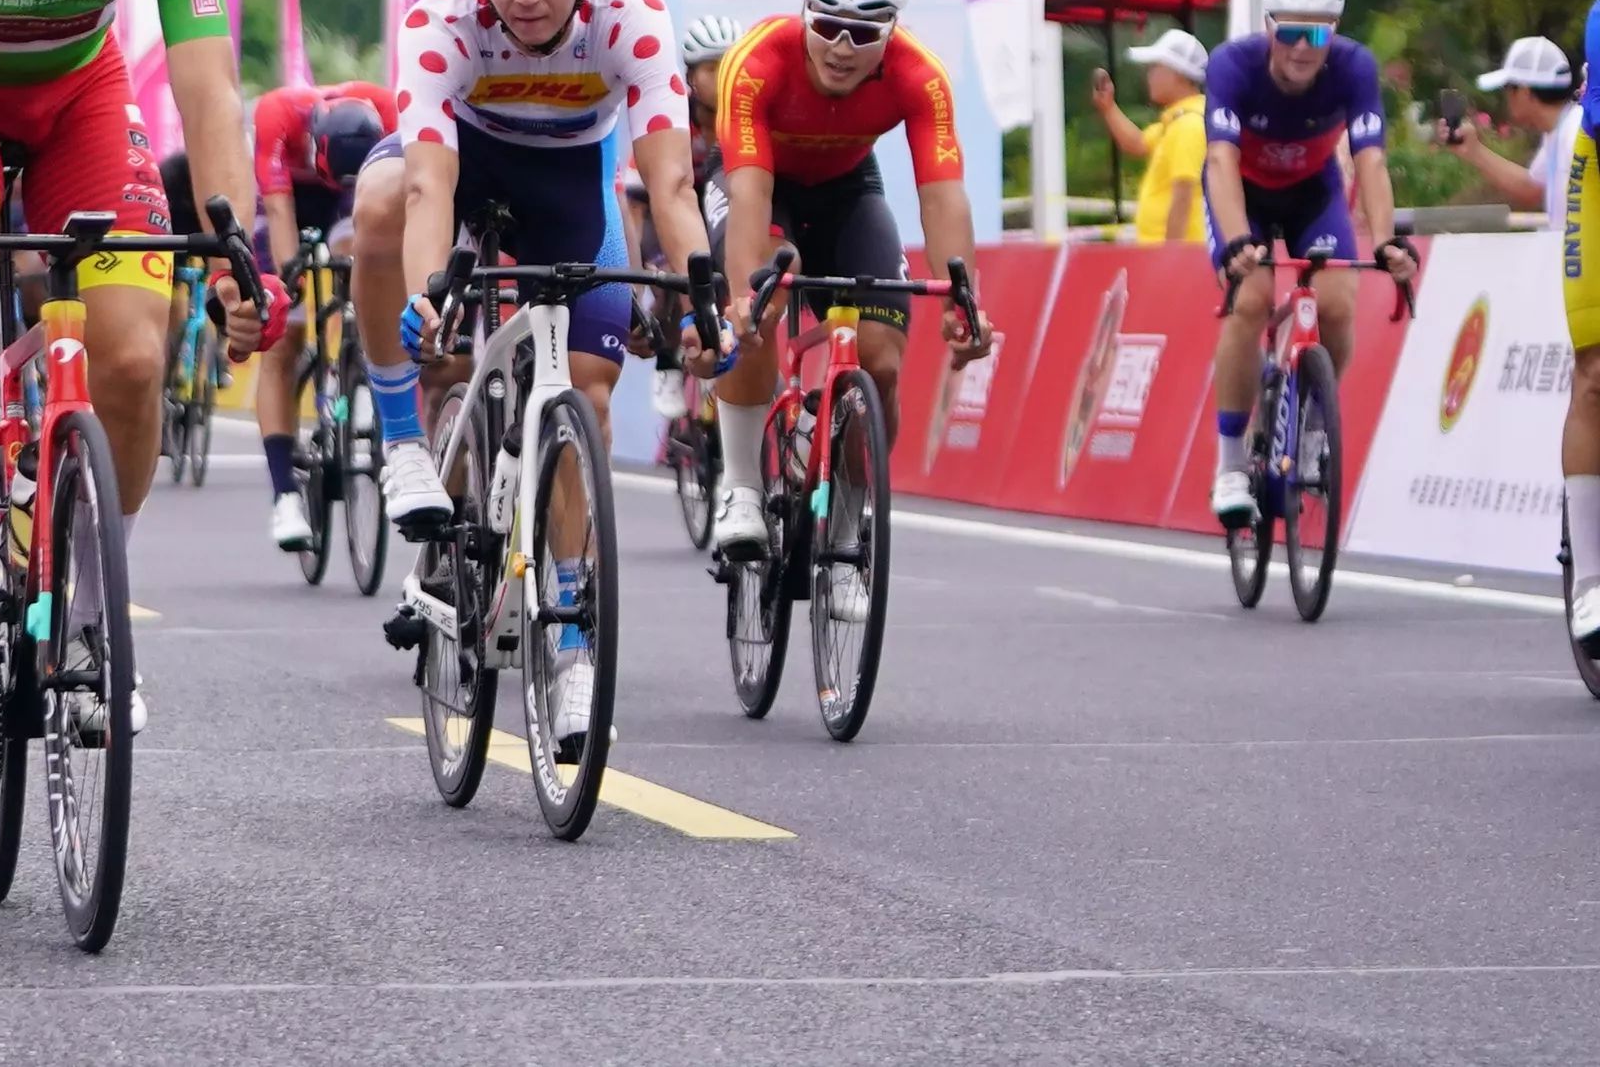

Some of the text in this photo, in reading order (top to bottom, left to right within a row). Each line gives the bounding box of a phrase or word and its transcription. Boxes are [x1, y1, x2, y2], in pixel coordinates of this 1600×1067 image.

[488, 79, 593, 105] DHL
[734, 65, 765, 157] bossini.X
[924, 76, 960, 164] bossini.X
[1563, 153, 1589, 279] THAILAND
[550, 321, 559, 371] LOOK
